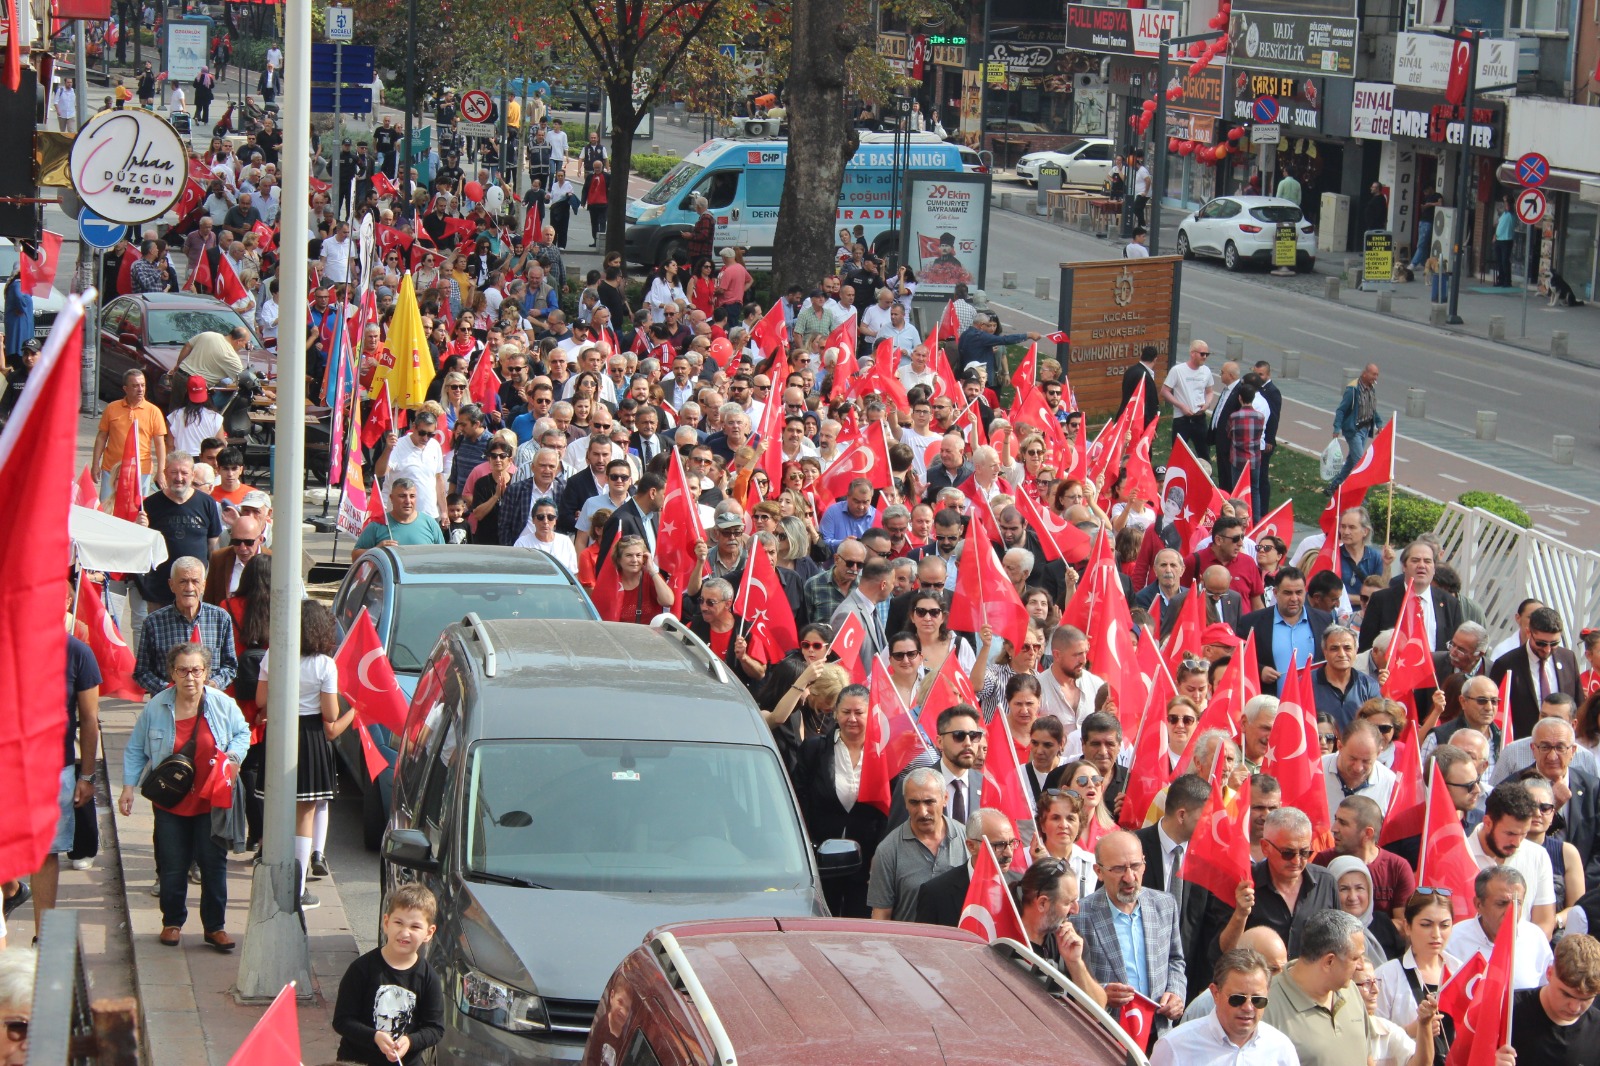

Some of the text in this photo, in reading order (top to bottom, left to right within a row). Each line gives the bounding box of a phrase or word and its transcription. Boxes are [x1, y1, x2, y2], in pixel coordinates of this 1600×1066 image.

[1069, 8, 1127, 31] FULL MEDYA
[1138, 13, 1175, 38] ALSAT
[1281, 78, 1293, 96] ET
[1295, 109, 1317, 128] SUCUK
[1394, 109, 1428, 138] EMRE
[762, 153, 779, 162] CHP
[104, 170, 174, 185] DÜZGÜN
[856, 173, 873, 184] bir
[113, 184, 172, 197] Bay & Bayan
[850, 190, 904, 203] çoğunlk
[928, 185, 970, 200] 29 Ekim
[128, 196, 156, 206] Salon
[1071, 342, 1129, 363] CUMHURİYET
